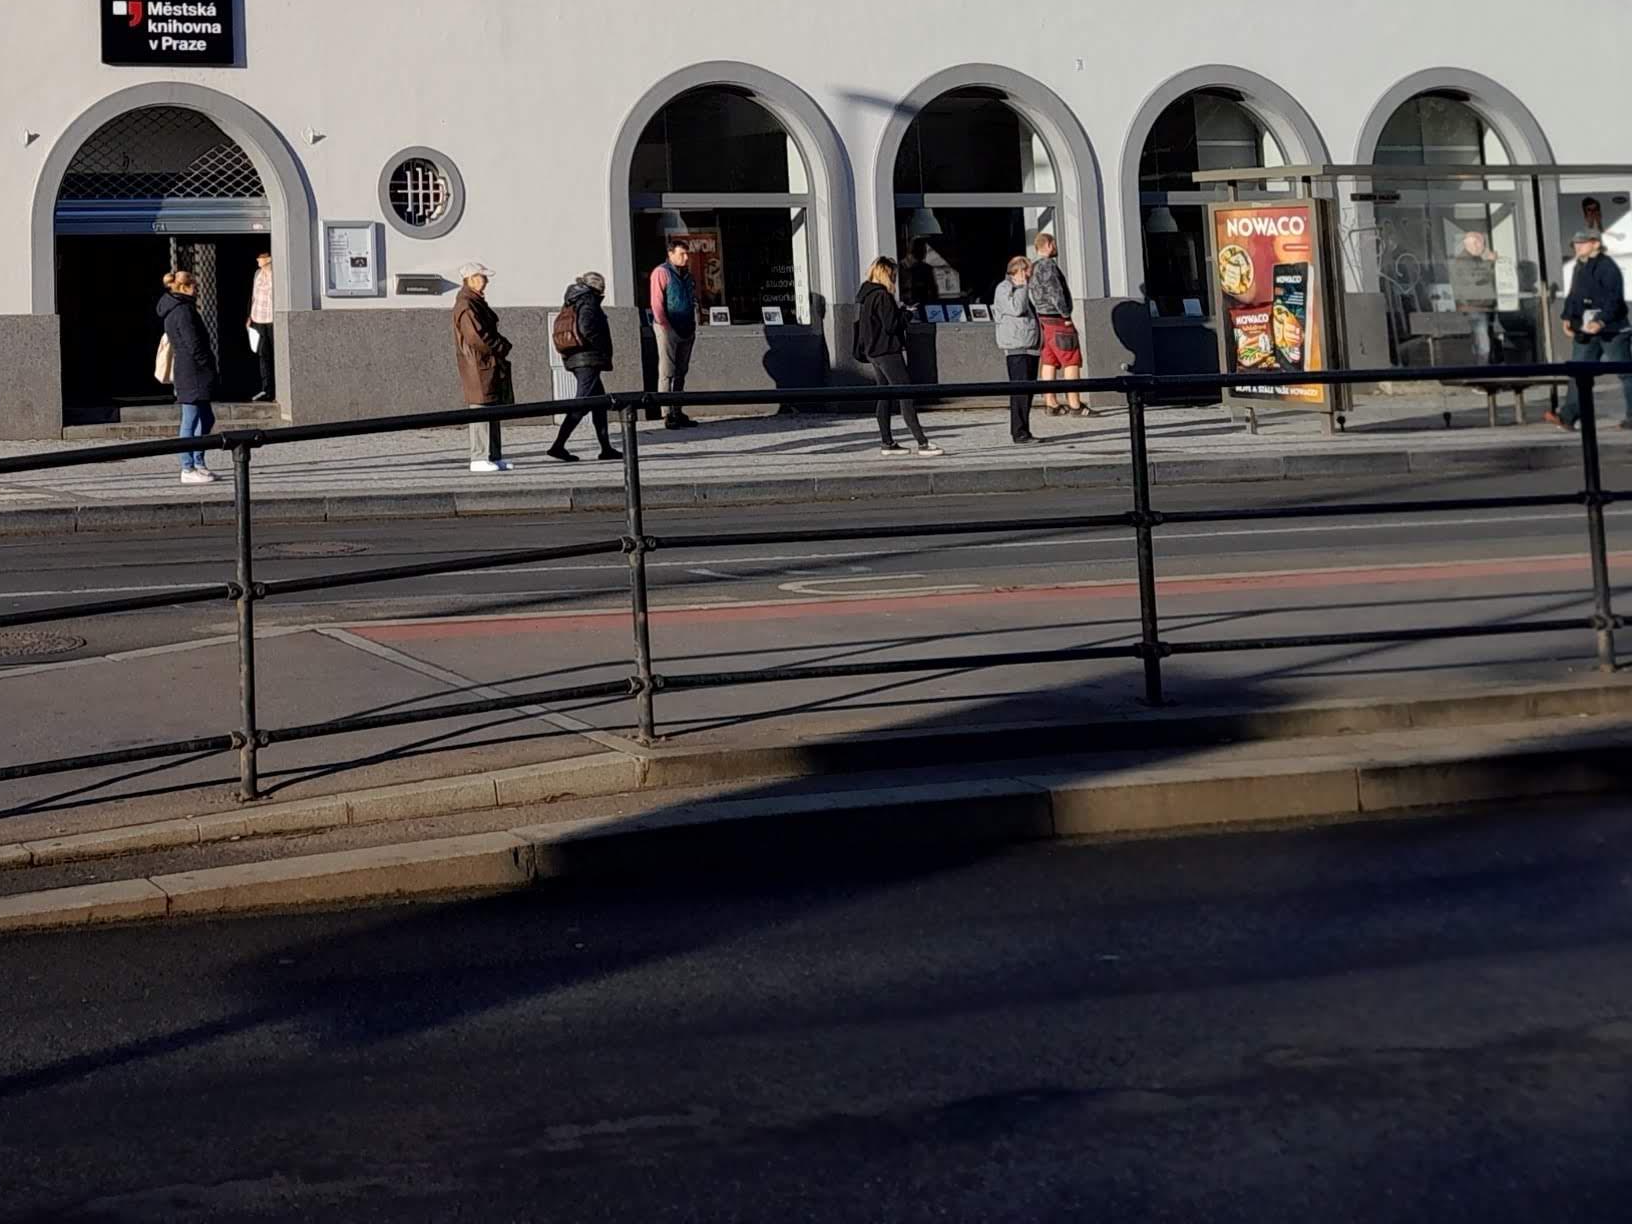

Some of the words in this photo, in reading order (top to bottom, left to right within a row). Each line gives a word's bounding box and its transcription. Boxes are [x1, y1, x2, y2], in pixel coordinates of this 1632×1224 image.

[147, 1, 216, 16] Městská
[148, 19, 222, 34] knihovna
[149, 40, 158, 51] v
[161, 37, 207, 51] Praze
[1226, 216, 1305, 237] NOWACO
[1235, 313, 1269, 325] NOWACO
